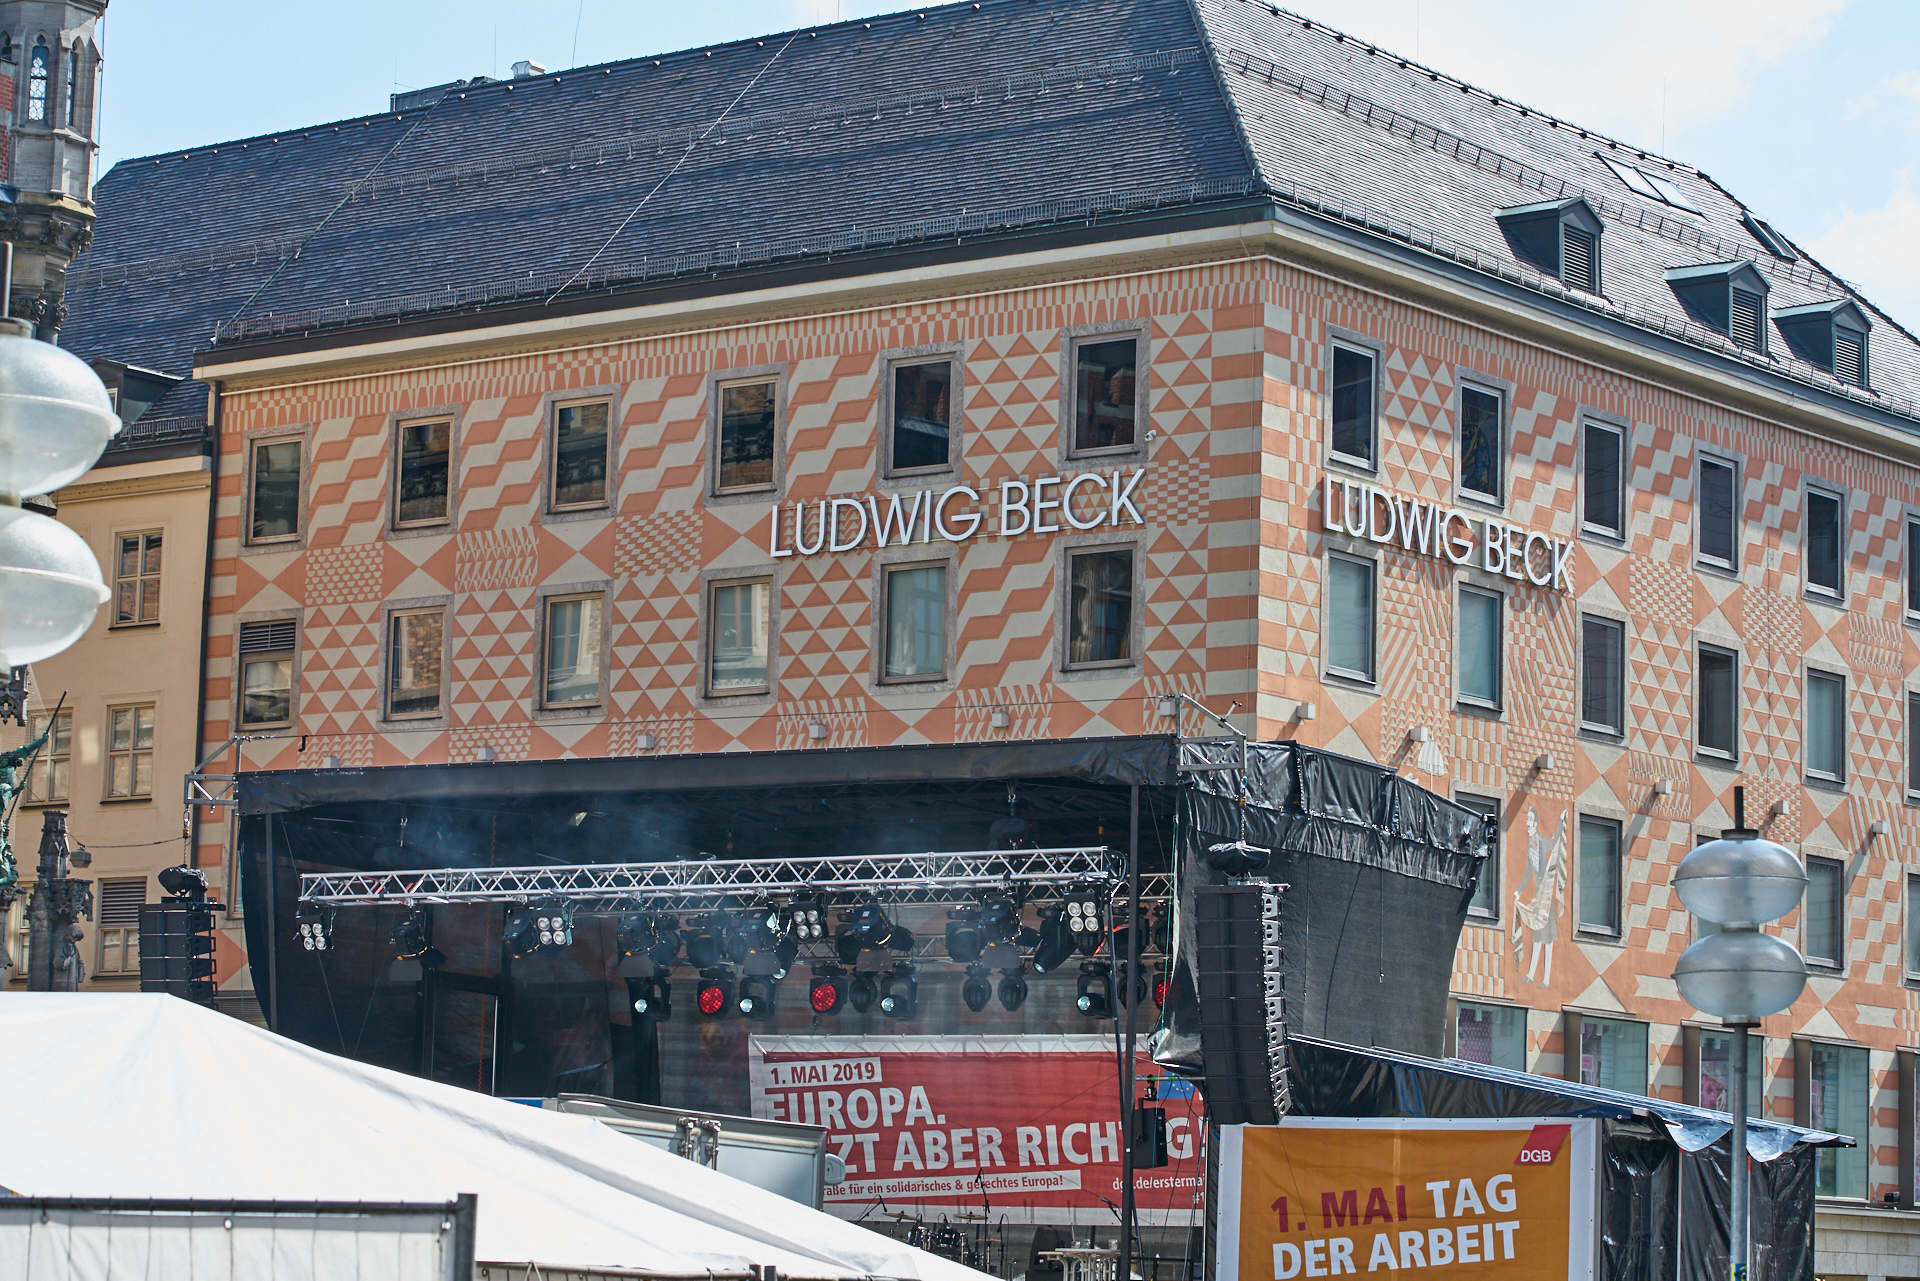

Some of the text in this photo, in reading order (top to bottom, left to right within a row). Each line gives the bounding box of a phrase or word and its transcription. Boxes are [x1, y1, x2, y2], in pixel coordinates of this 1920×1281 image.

[770, 469, 1147, 557] LUDWIG BECK
[1323, 474, 1575, 593] LUDWIG BECK
[771, 1062, 875, 1084] 1. MAI 2019
[765, 1085, 946, 1129] EUROPA.
[893, 1127, 1006, 1171] ABER
[1519, 1149, 1552, 1163] DGB
[823, 1184, 846, 1196] raße
[849, 1183, 865, 1195] für
[868, 1183, 883, 1193] ein
[886, 1179, 952, 1193] solidarisches
[955, 1179, 963, 1190] &
[1022, 1174, 1063, 1189] Europa!
[1270, 1174, 1517, 1233] 1. MAI TAG
[1272, 1220, 1520, 1280] DER ARBEIT
